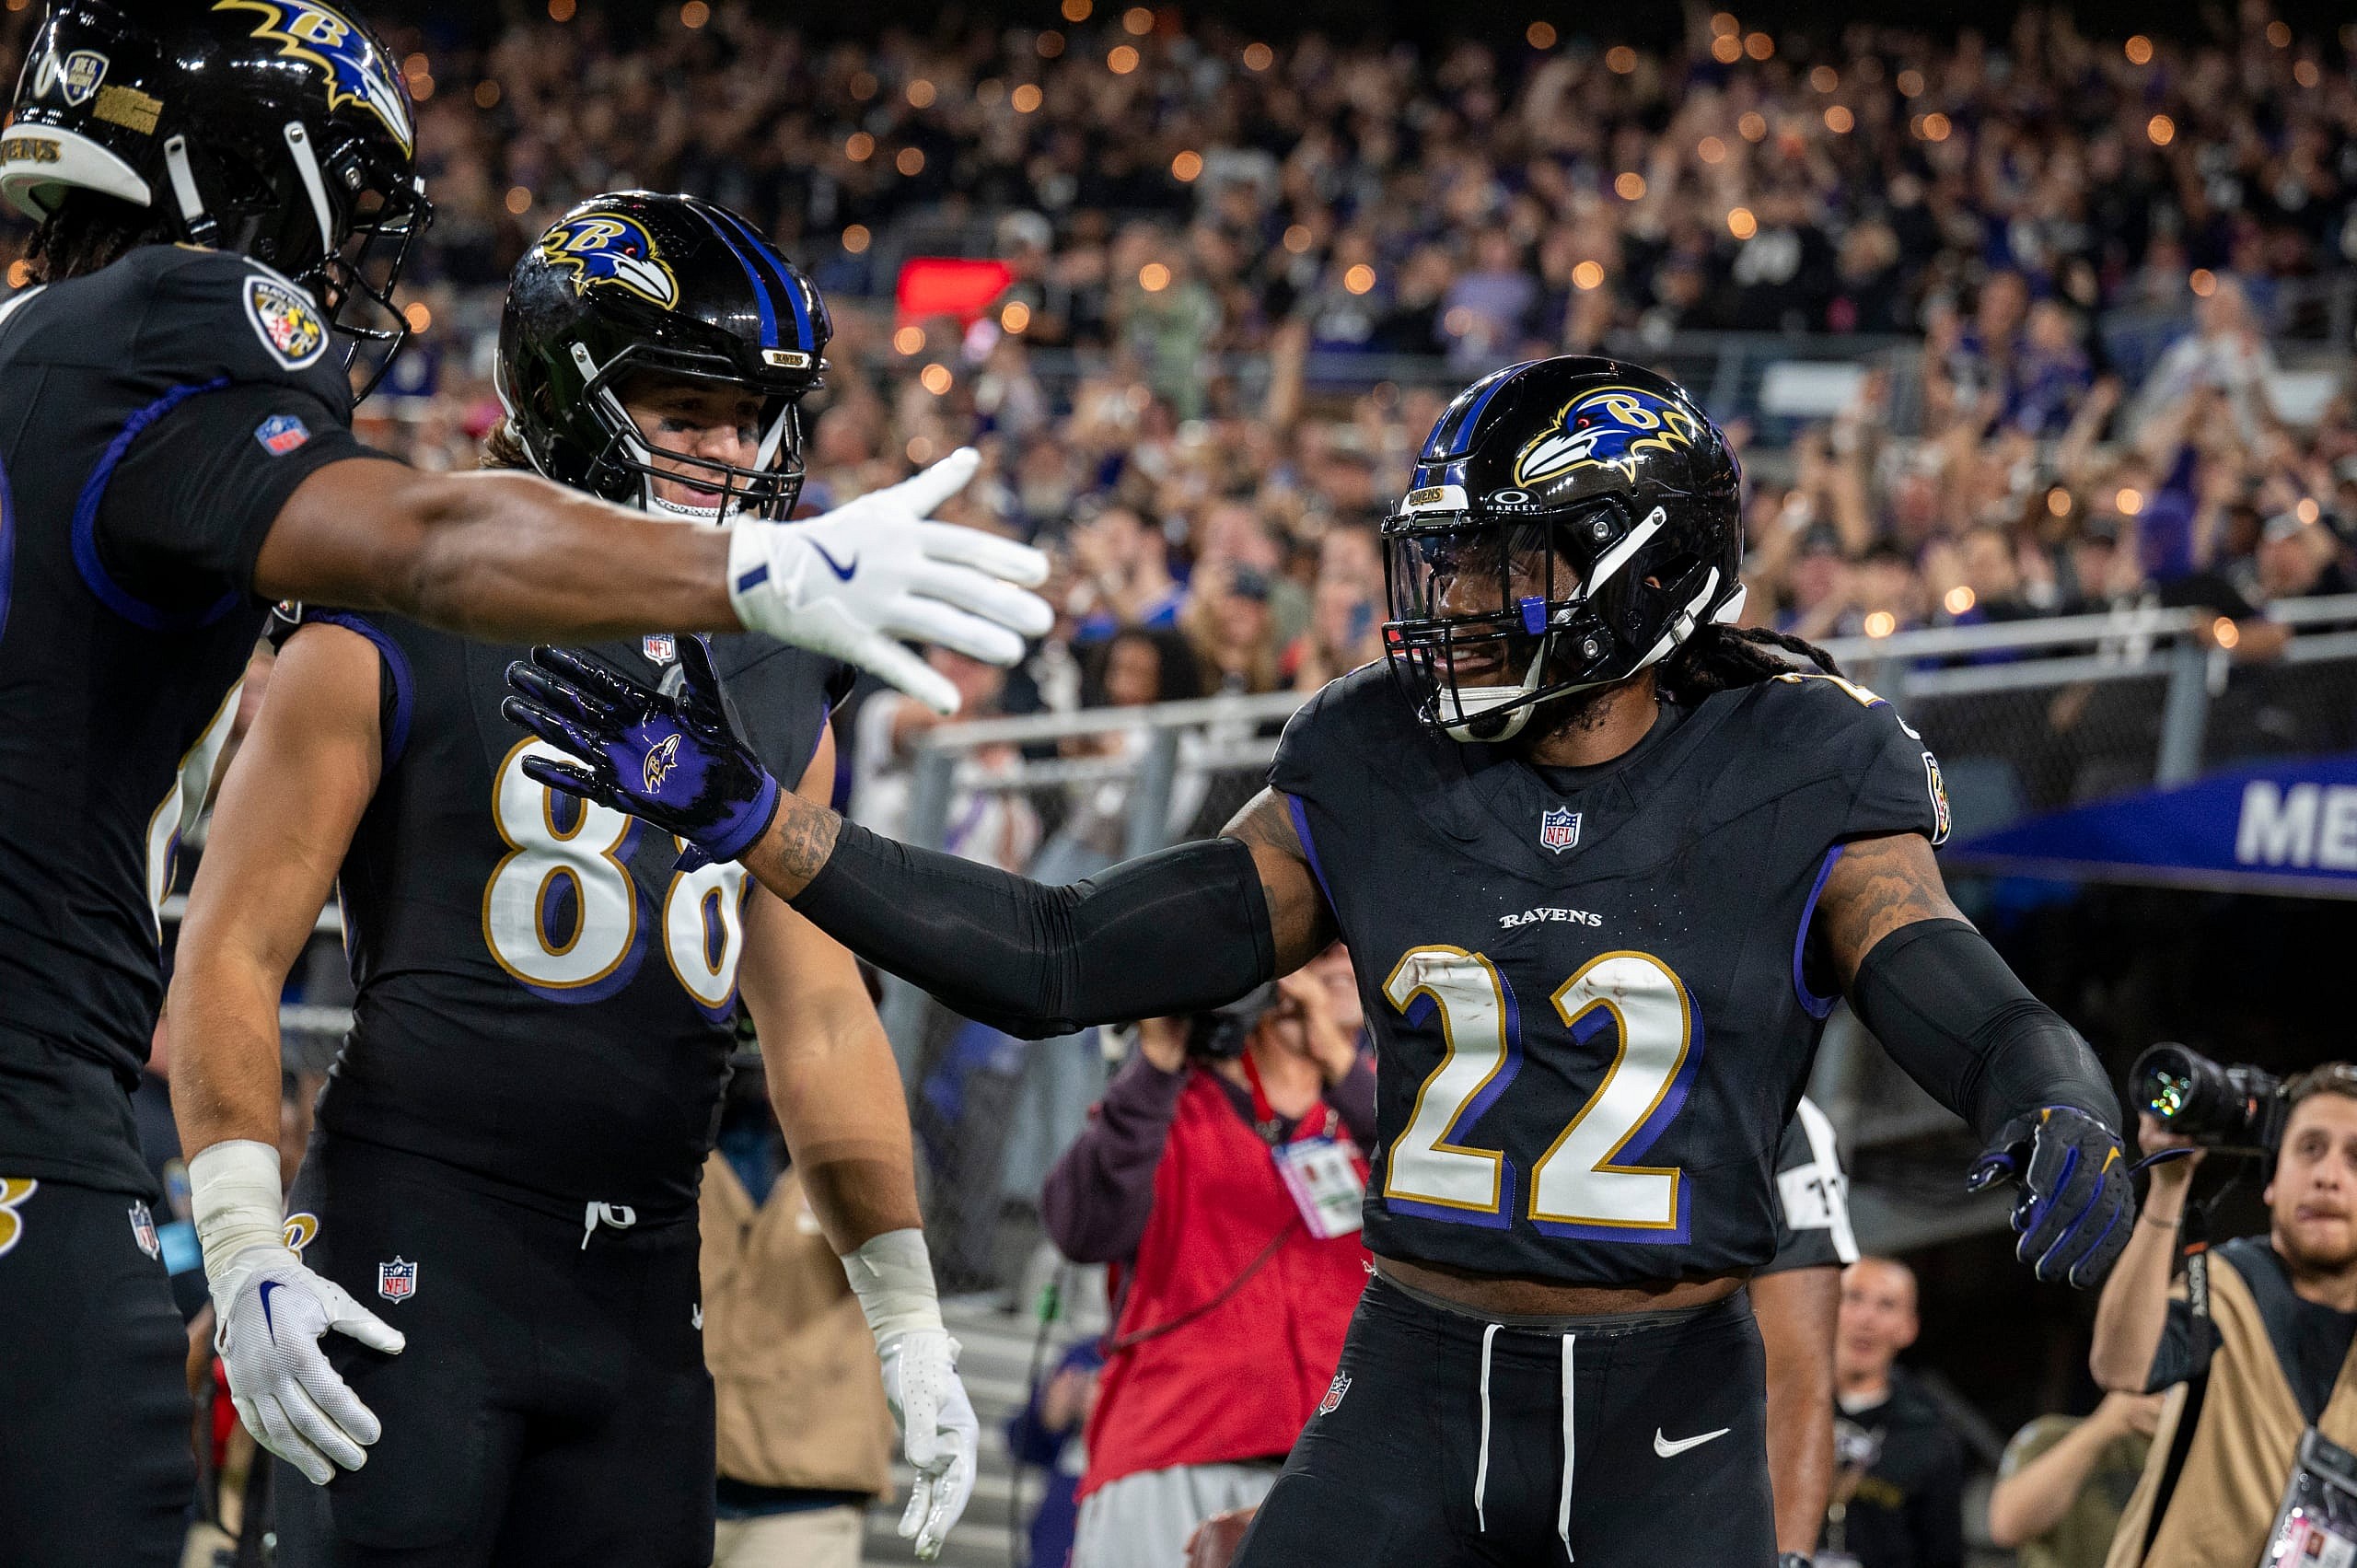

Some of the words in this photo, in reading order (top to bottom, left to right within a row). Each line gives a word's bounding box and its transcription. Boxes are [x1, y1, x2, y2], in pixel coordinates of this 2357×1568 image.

[287, 10, 350, 49] B
[564, 219, 626, 251] B
[772, 353, 803, 366] RAVENS
[1487, 504, 1538, 512] OAKLEY
[649, 640, 671, 656] NFL
[1547, 827, 1572, 844] NFL
[2235, 780, 2357, 871] ME
[1499, 907, 1603, 929] RAVENS
[1382, 945, 1699, 1240] 22
[385, 1277, 410, 1295] NFL
